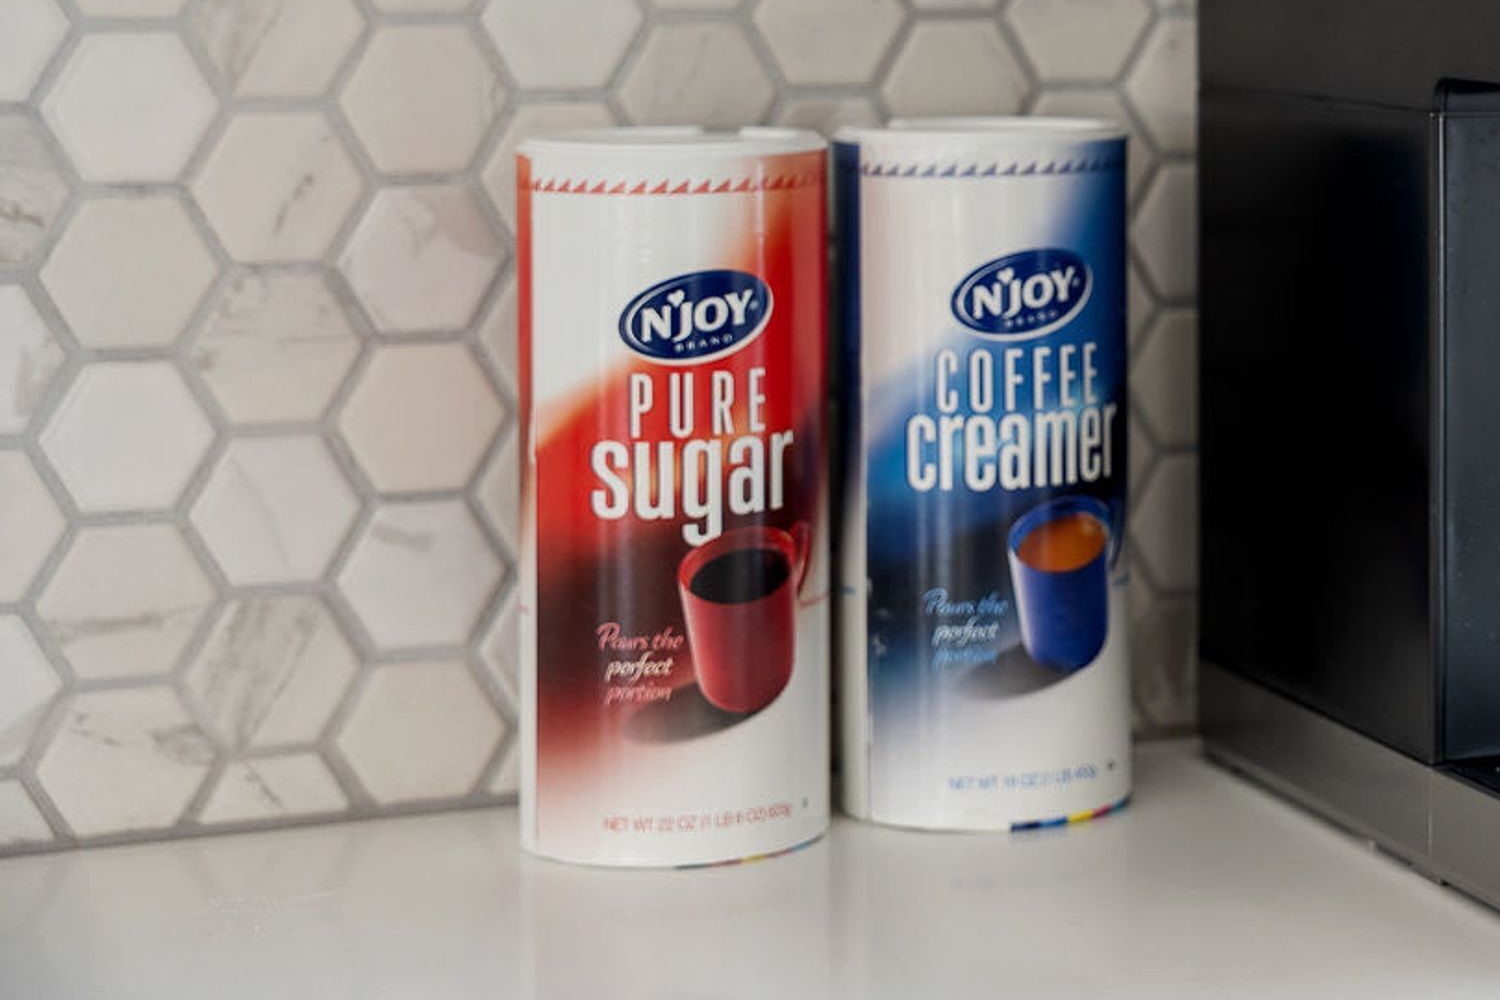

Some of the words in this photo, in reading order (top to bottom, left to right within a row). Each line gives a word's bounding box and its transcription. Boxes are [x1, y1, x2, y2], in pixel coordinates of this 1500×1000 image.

[630, 366, 767, 439] PURE
[936, 342, 1097, 414] COFFEE
[907, 402, 1118, 492] creamer
[590, 429, 795, 547] sugar
[603, 650, 674, 684] perfect
